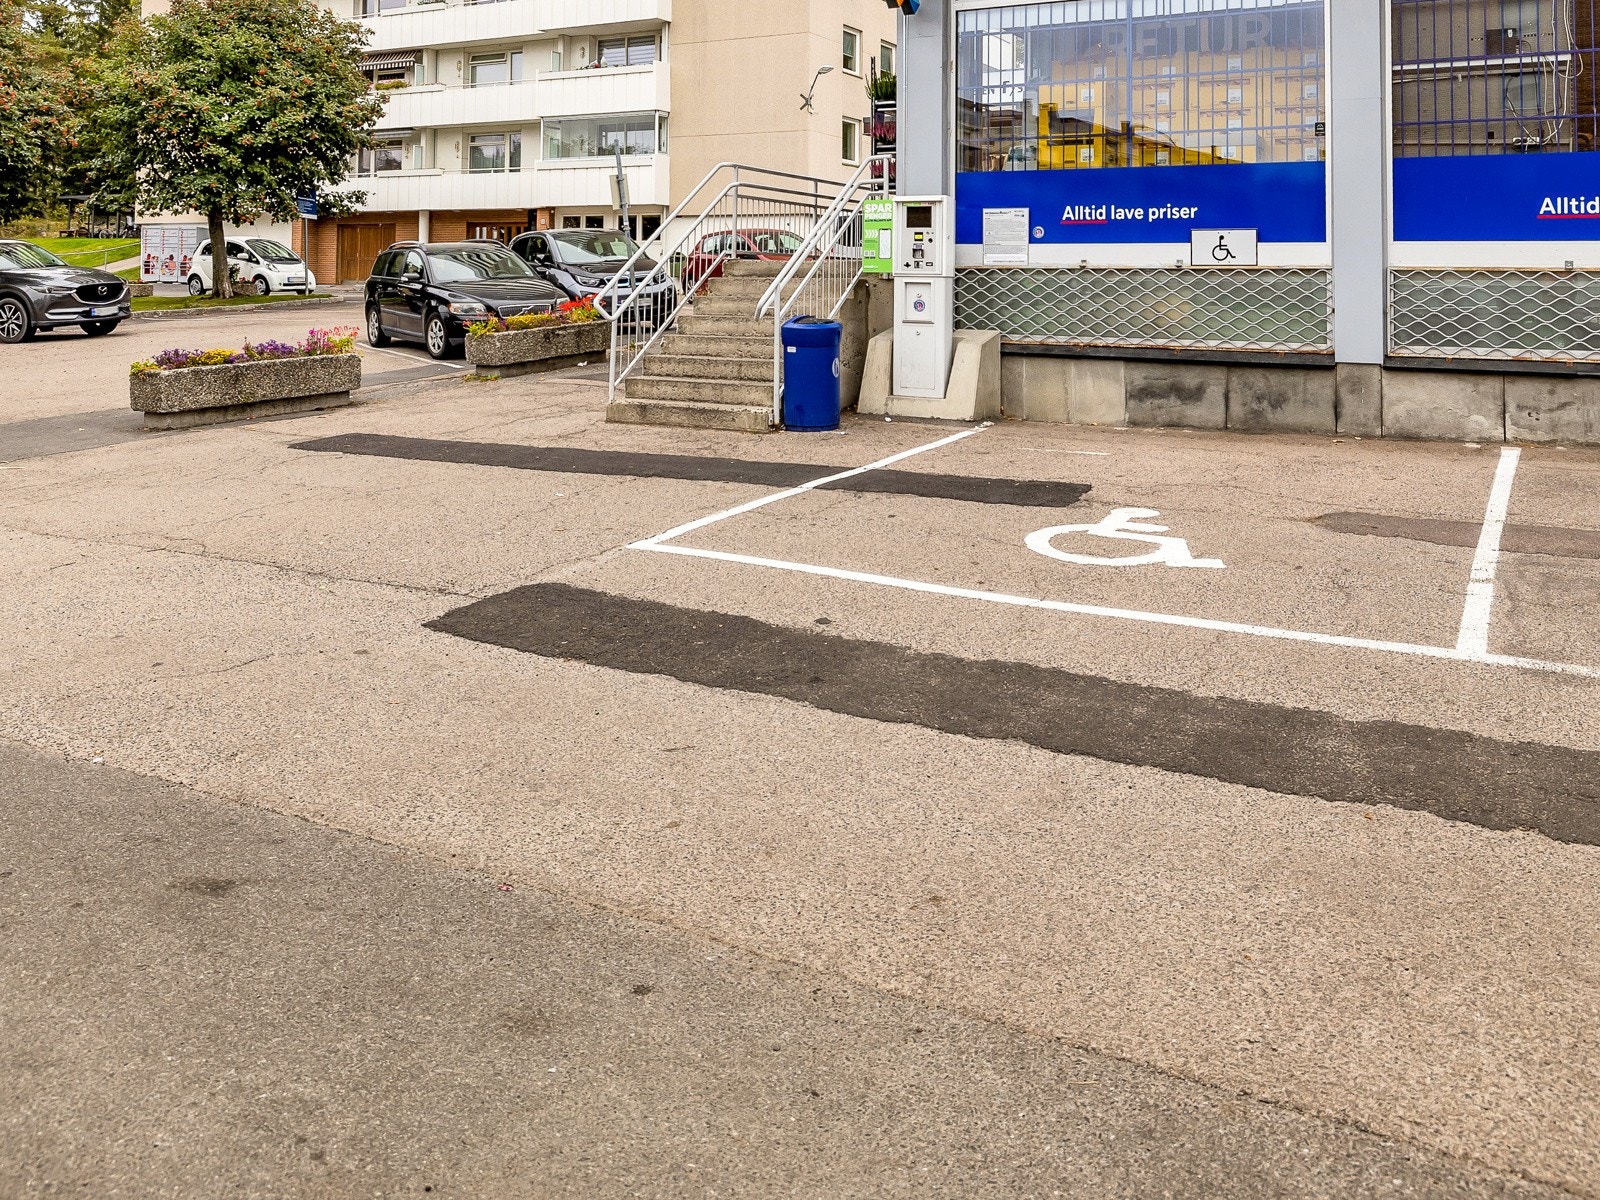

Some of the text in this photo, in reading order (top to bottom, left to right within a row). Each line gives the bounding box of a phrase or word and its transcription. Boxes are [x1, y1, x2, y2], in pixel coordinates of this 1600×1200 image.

[865, 203, 892, 213] SPAR
[1062, 203, 1198, 223] Alltid lave priser
[1540, 196, 1600, 215] Alltid
